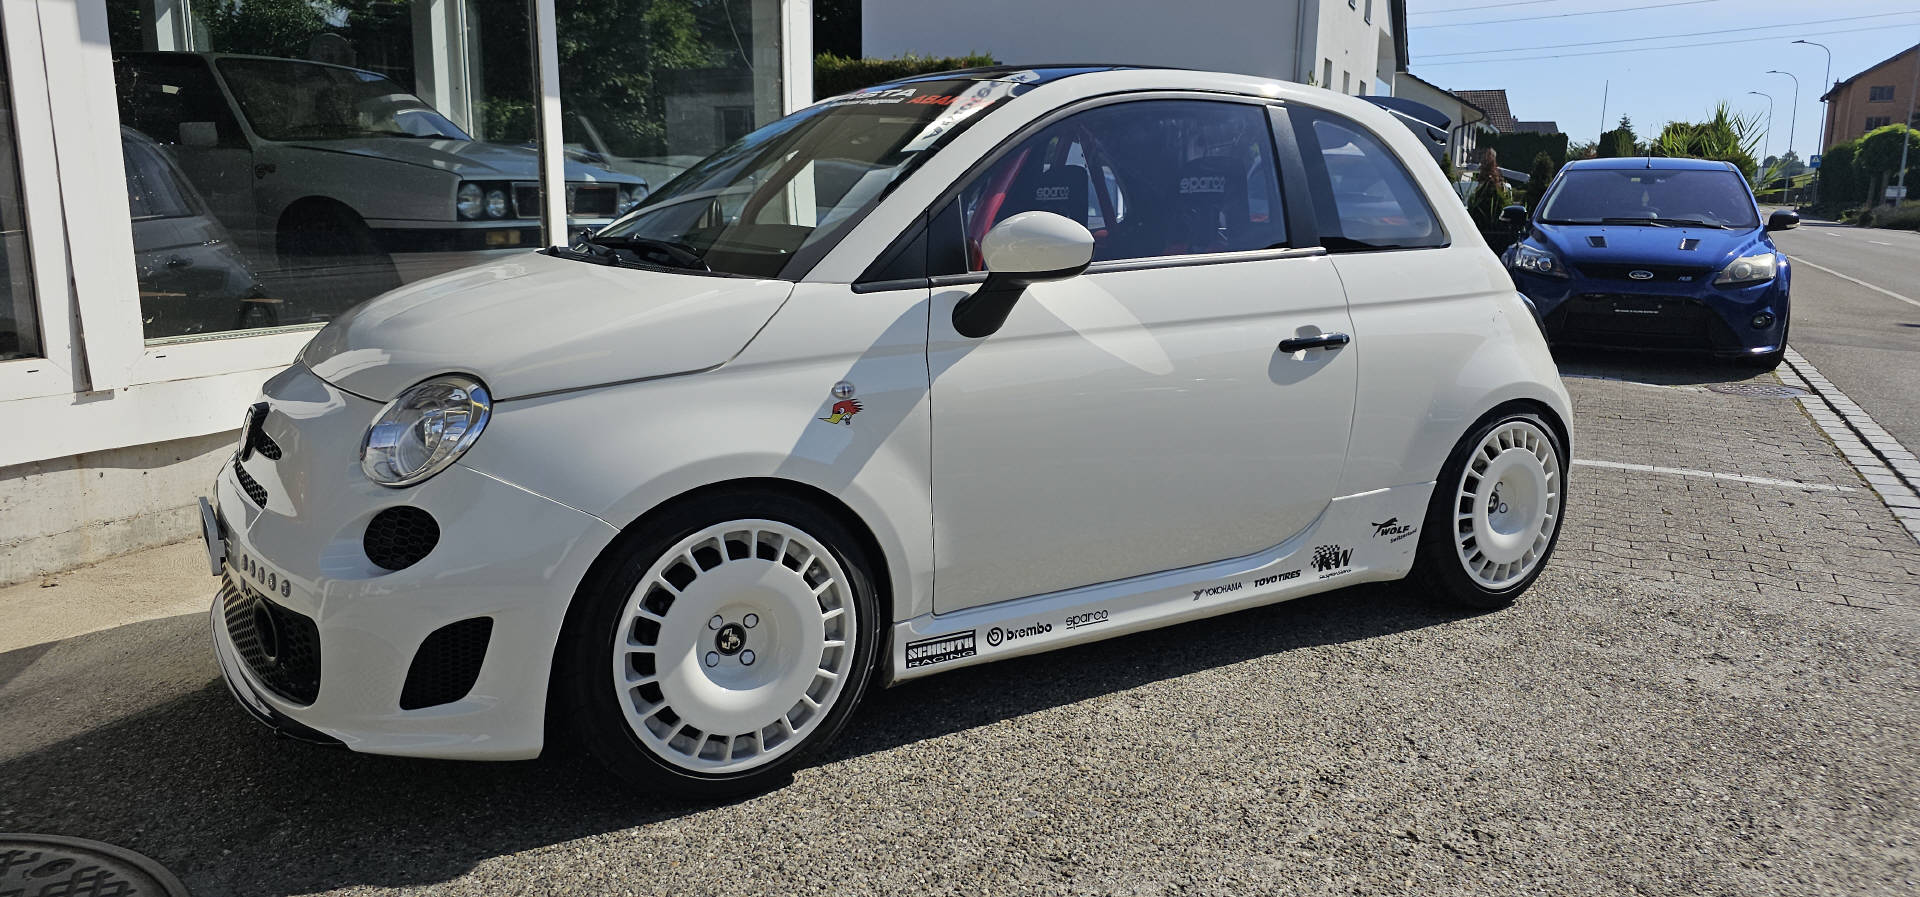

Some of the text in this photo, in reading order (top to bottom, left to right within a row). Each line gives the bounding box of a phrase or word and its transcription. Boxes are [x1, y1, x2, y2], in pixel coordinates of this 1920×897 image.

[1380, 524, 1411, 536] WOLF
[1254, 569, 1302, 588] TOYO TIRES
[1204, 581, 1242, 596] YOKOHAMA
[1065, 609, 1109, 630] sparco
[1006, 621, 1053, 641] brembo
[908, 637, 974, 660] SCHROTH
[908, 650, 975, 668] RACING
